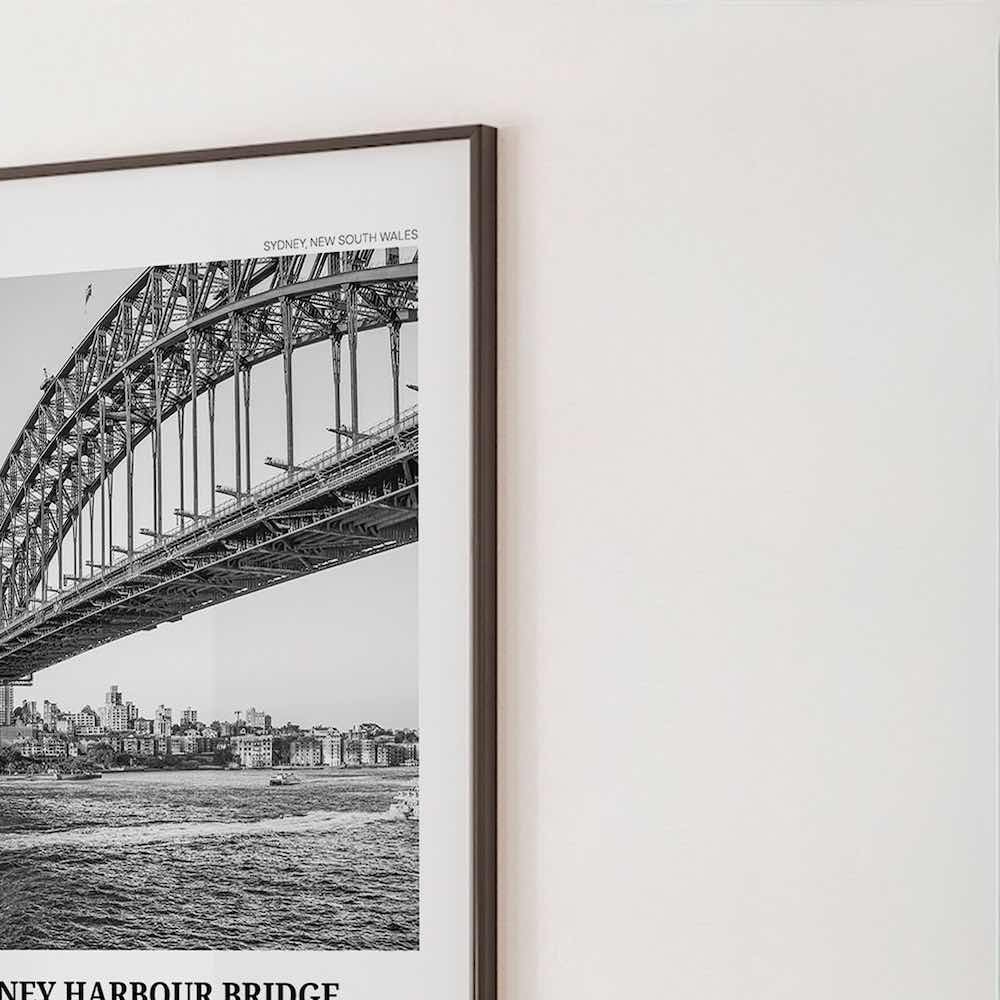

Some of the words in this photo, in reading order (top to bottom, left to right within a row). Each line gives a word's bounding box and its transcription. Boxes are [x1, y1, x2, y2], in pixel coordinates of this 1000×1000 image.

[263, 238, 308, 251] SYDNEY,
[309, 236, 336, 248] NEW
[337, 232, 378, 246] SOUTH
[378, 229, 419, 242] WALES
